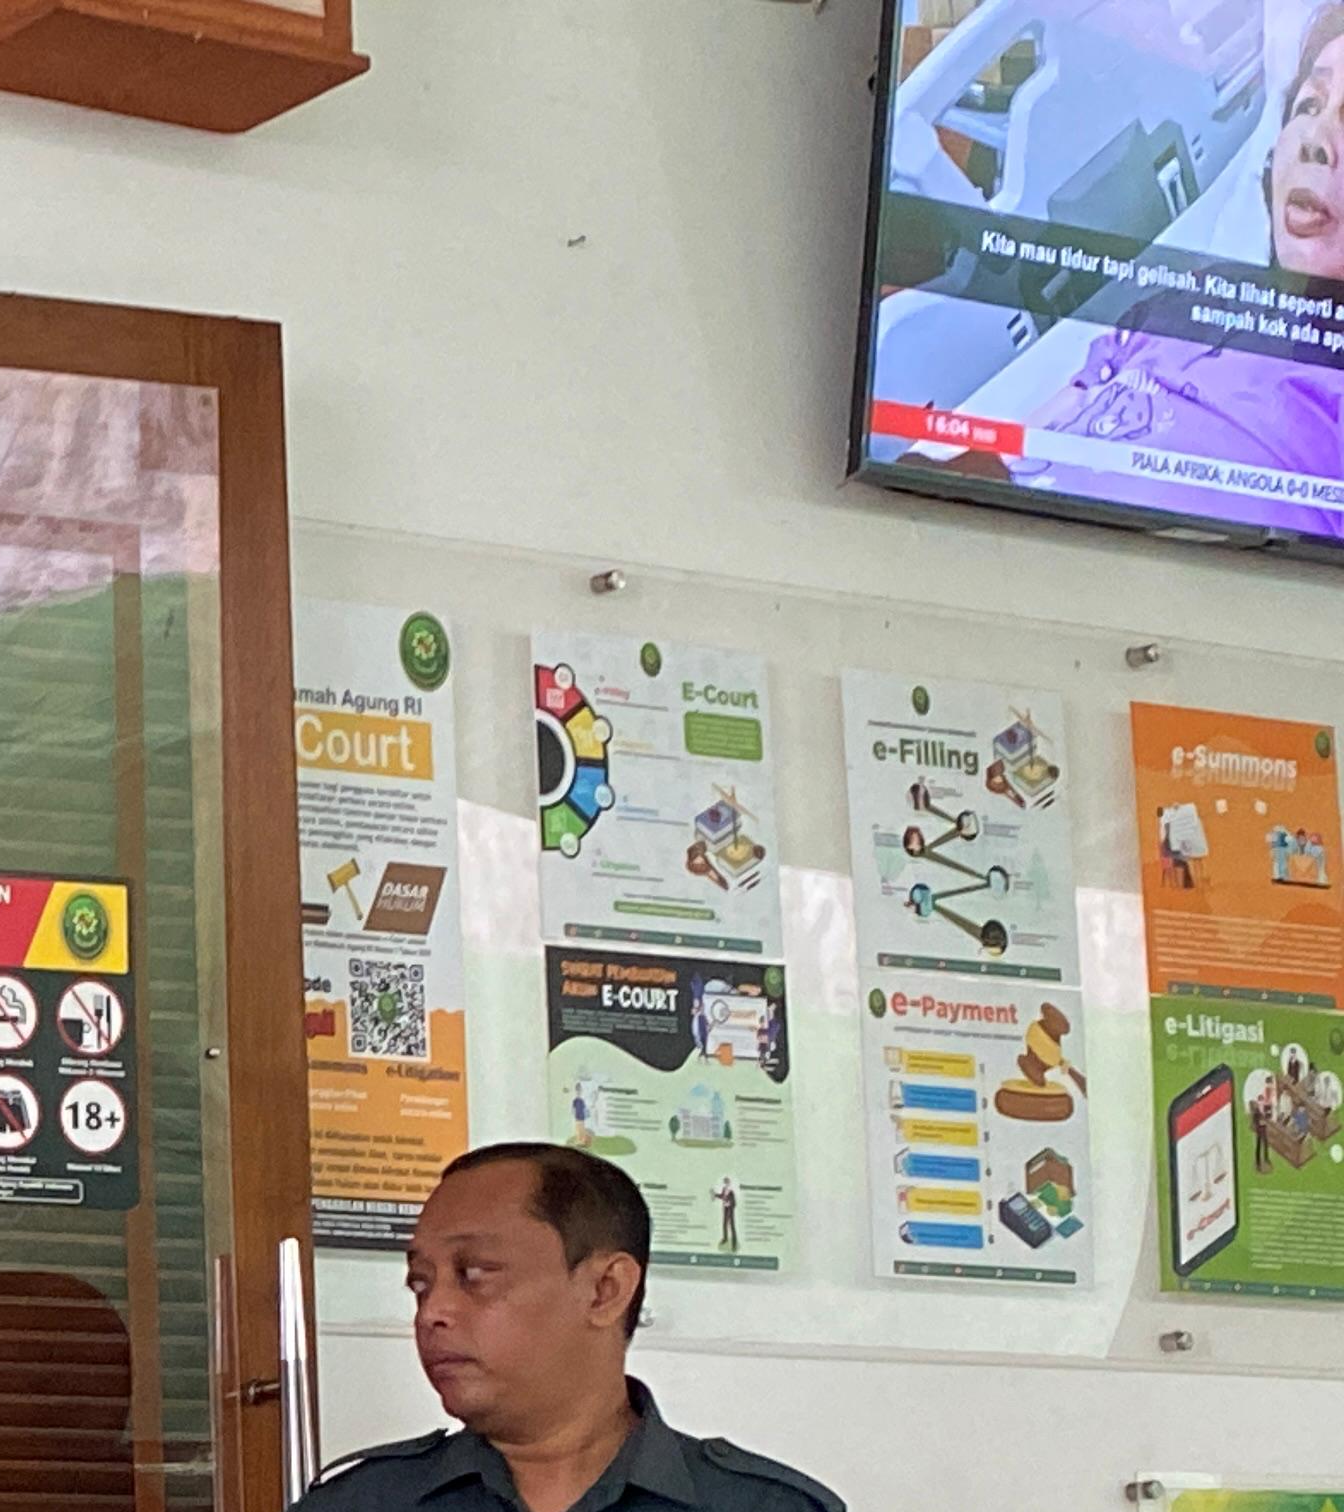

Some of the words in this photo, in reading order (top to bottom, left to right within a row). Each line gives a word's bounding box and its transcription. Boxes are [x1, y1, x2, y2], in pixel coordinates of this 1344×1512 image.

[981, 230, 1016, 257] Kita
[1020, 242, 1056, 264] mau
[1061, 246, 1100, 272] tidur
[1102, 255, 1135, 282] tapi
[1137, 265, 1201, 292] gelisah.
[1204, 273, 1237, 299] Kita
[1239, 281, 1275, 308] lihat
[1191, 304, 1255, 333] sampah
[1258, 313, 1288, 338] kok
[1291, 322, 1320, 345] ada
[1131, 451, 1171, 475] PIALA
[1226, 468, 1284, 495] ANGOLA
[341, 688, 399, 717] Agung
[404, 695, 423, 716] RI
[681, 681, 759, 709] E-Court
[872, 738, 979, 777] e-Filling
[1171, 744, 1297, 779] e-Summons
[601, 984, 679, 1012] E-COURT
[891, 991, 1019, 1025] e-Payment
[1164, 1013, 1264, 1045] e-Litigasi
[64, 1101, 121, 1132] 18+
